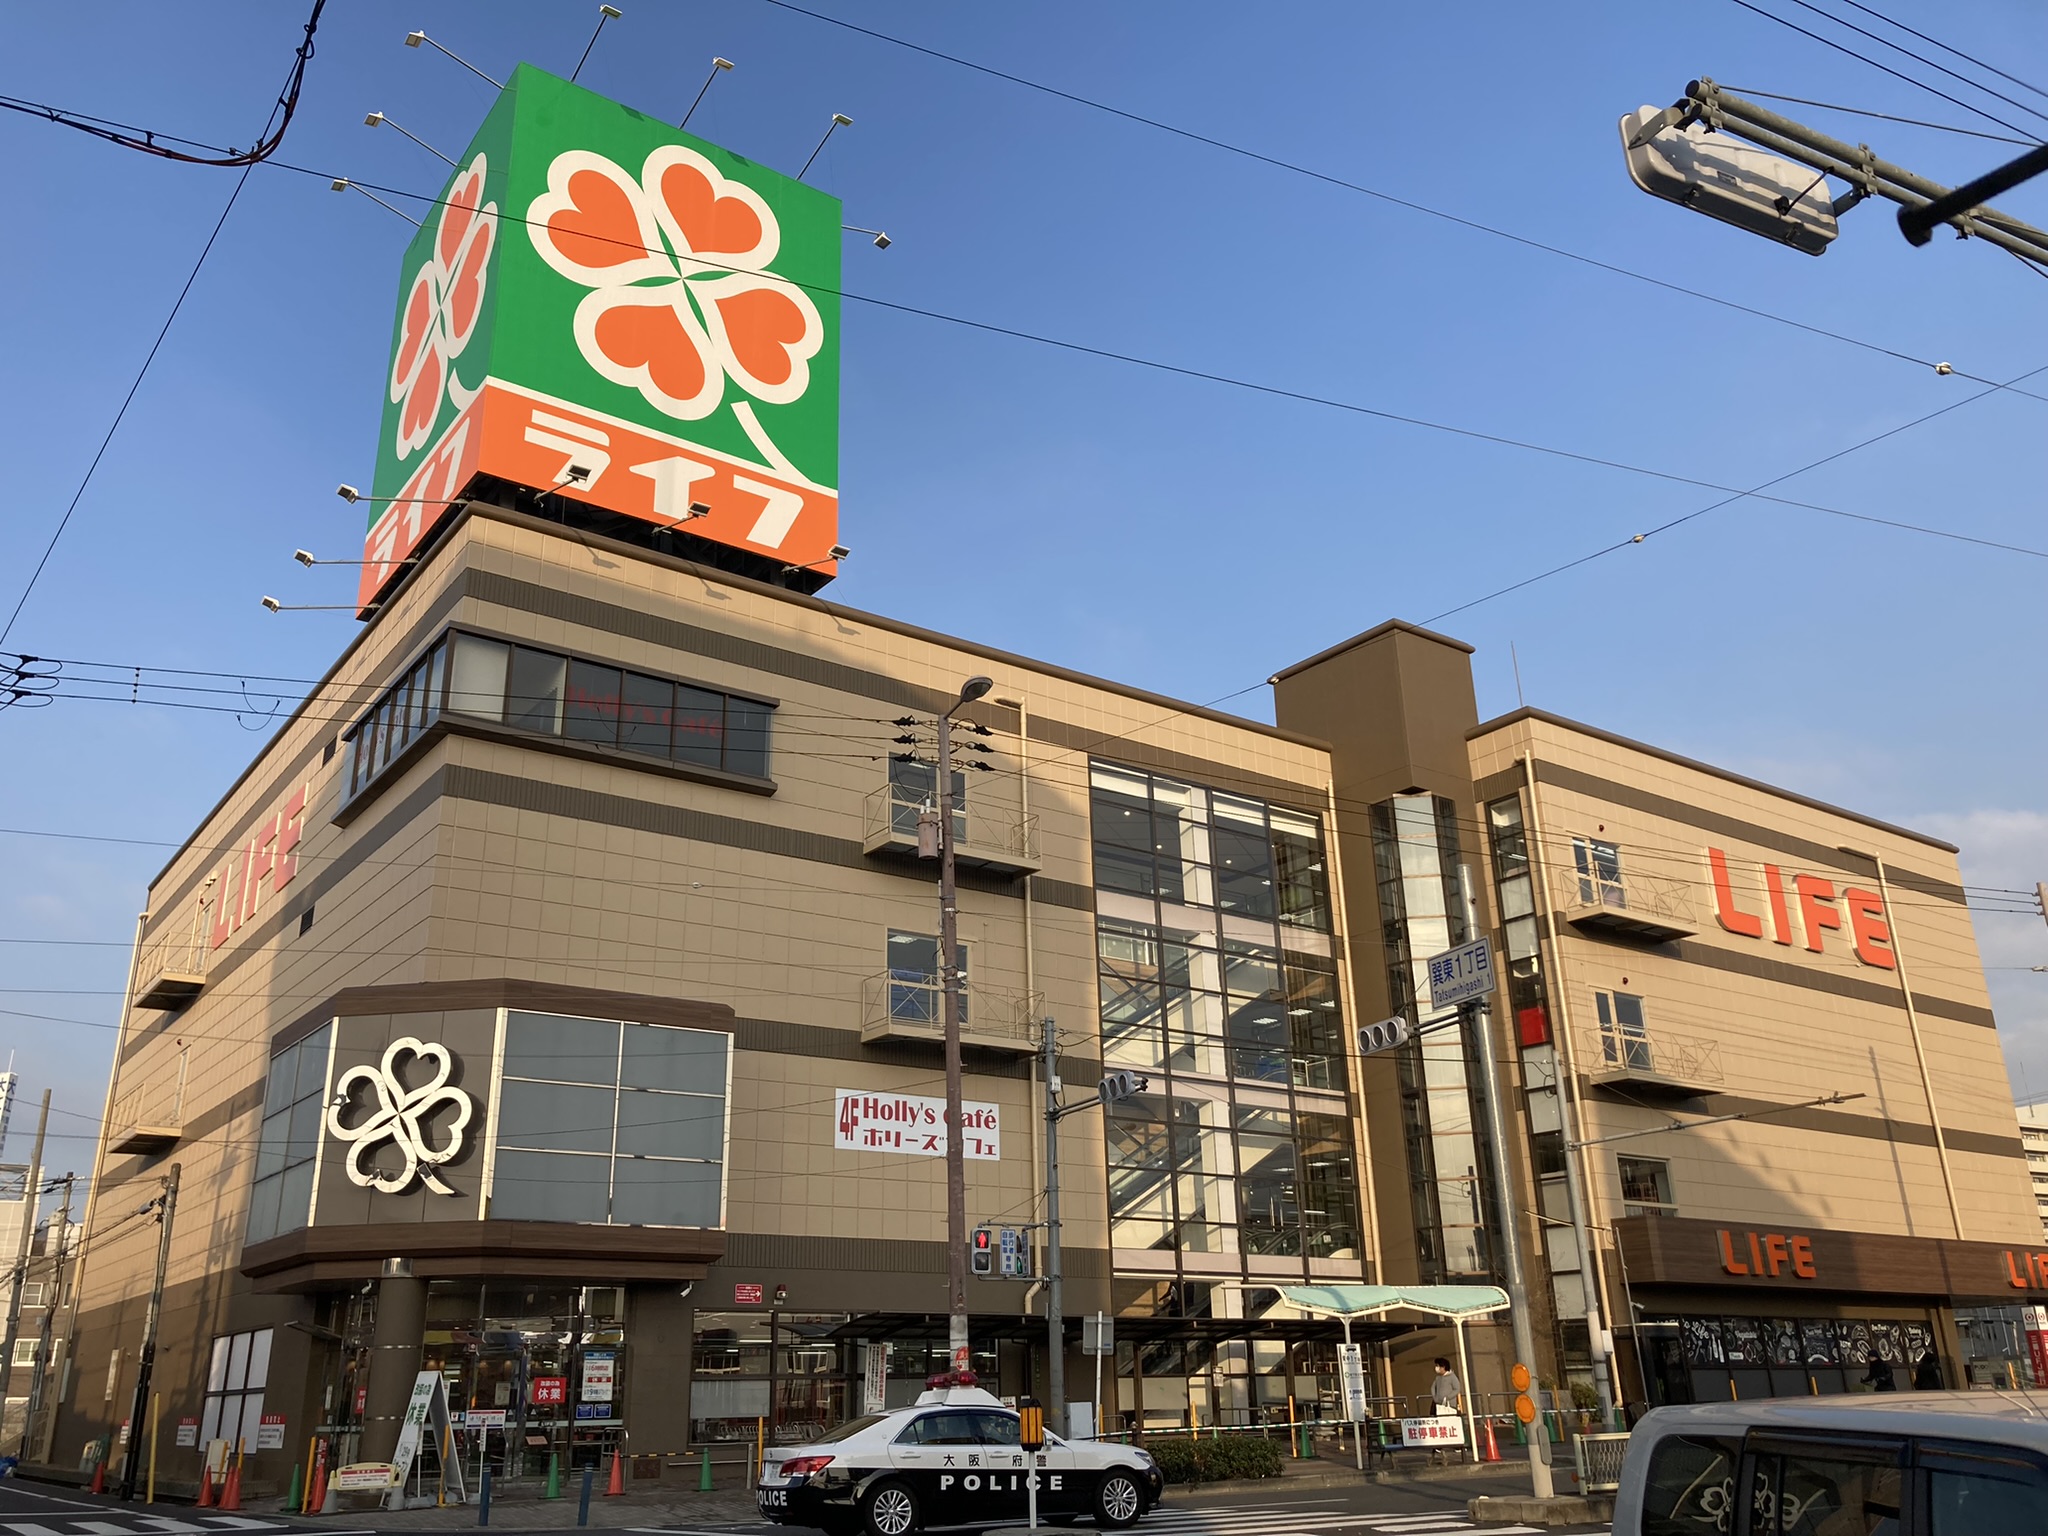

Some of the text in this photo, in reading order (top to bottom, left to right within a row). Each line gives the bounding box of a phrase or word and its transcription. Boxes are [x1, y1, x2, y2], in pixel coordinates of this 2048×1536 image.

[524, 409, 804, 549] ライフ
[211, 782, 309, 950] LIFE
[1702, 846, 1895, 970] LIFE
[1431, 946, 1487, 987] 巽東1丁目
[839, 1096, 859, 1141] 4F
[863, 1097, 936, 1127] Holly's
[863, 1128, 997, 1156] ホリーズフェ
[1716, 1229, 1817, 1278] LIFE
[538, 1388, 561, 1400] 休業
[1407, 1426, 1458, 1440] 駐停車禁止
[943, 1454, 1047, 1467] 大阪府警
[940, 1475, 1063, 1491] POLICE
